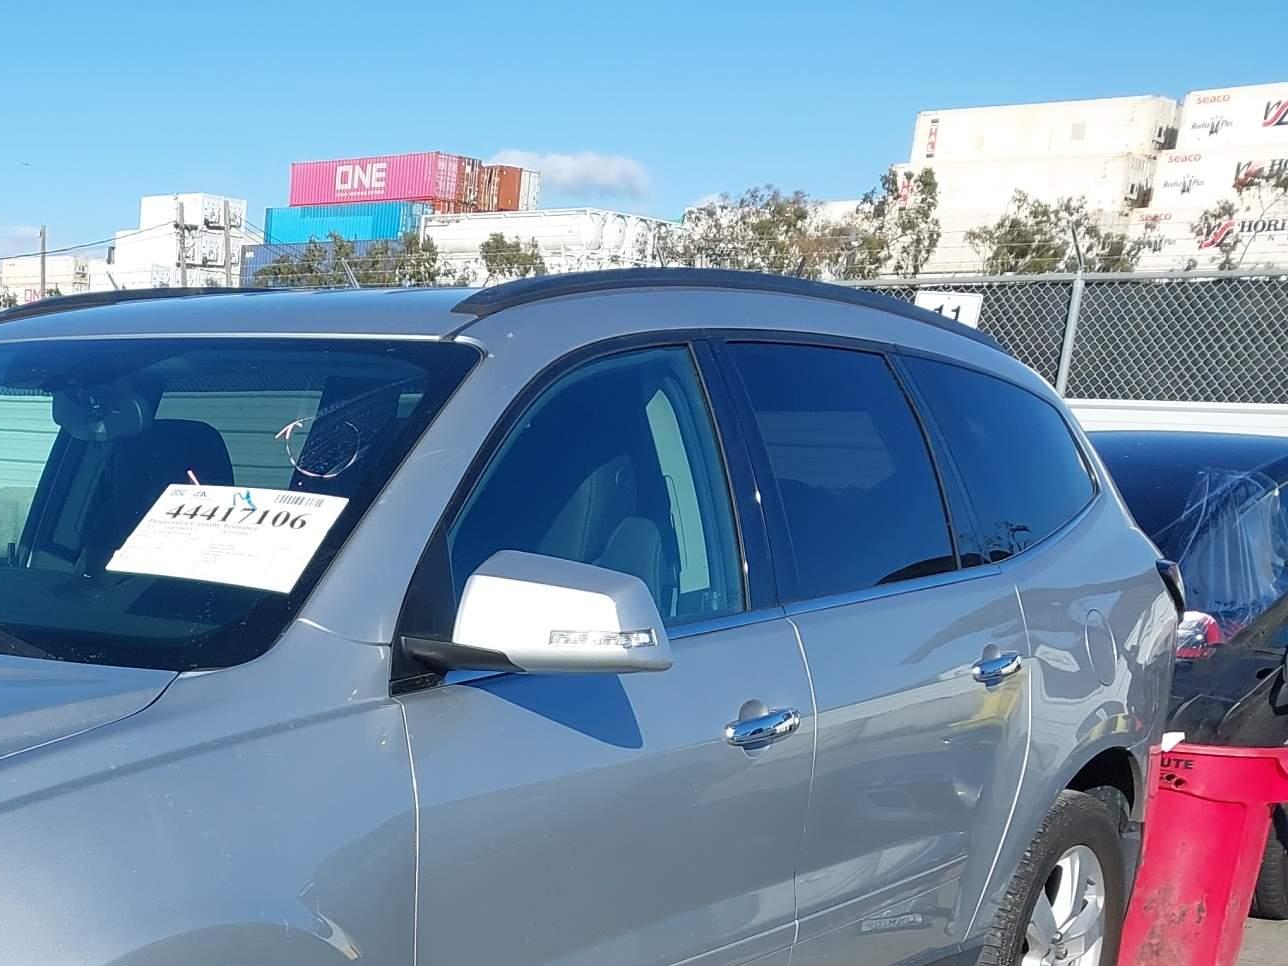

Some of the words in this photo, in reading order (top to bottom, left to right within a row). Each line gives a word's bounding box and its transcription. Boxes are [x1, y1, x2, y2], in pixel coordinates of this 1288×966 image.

[1196, 94, 1231, 105] seaco
[1168, 153, 1202, 163] seaco
[336, 162, 387, 191] ONE
[166, 503, 312, 530] 44417106
